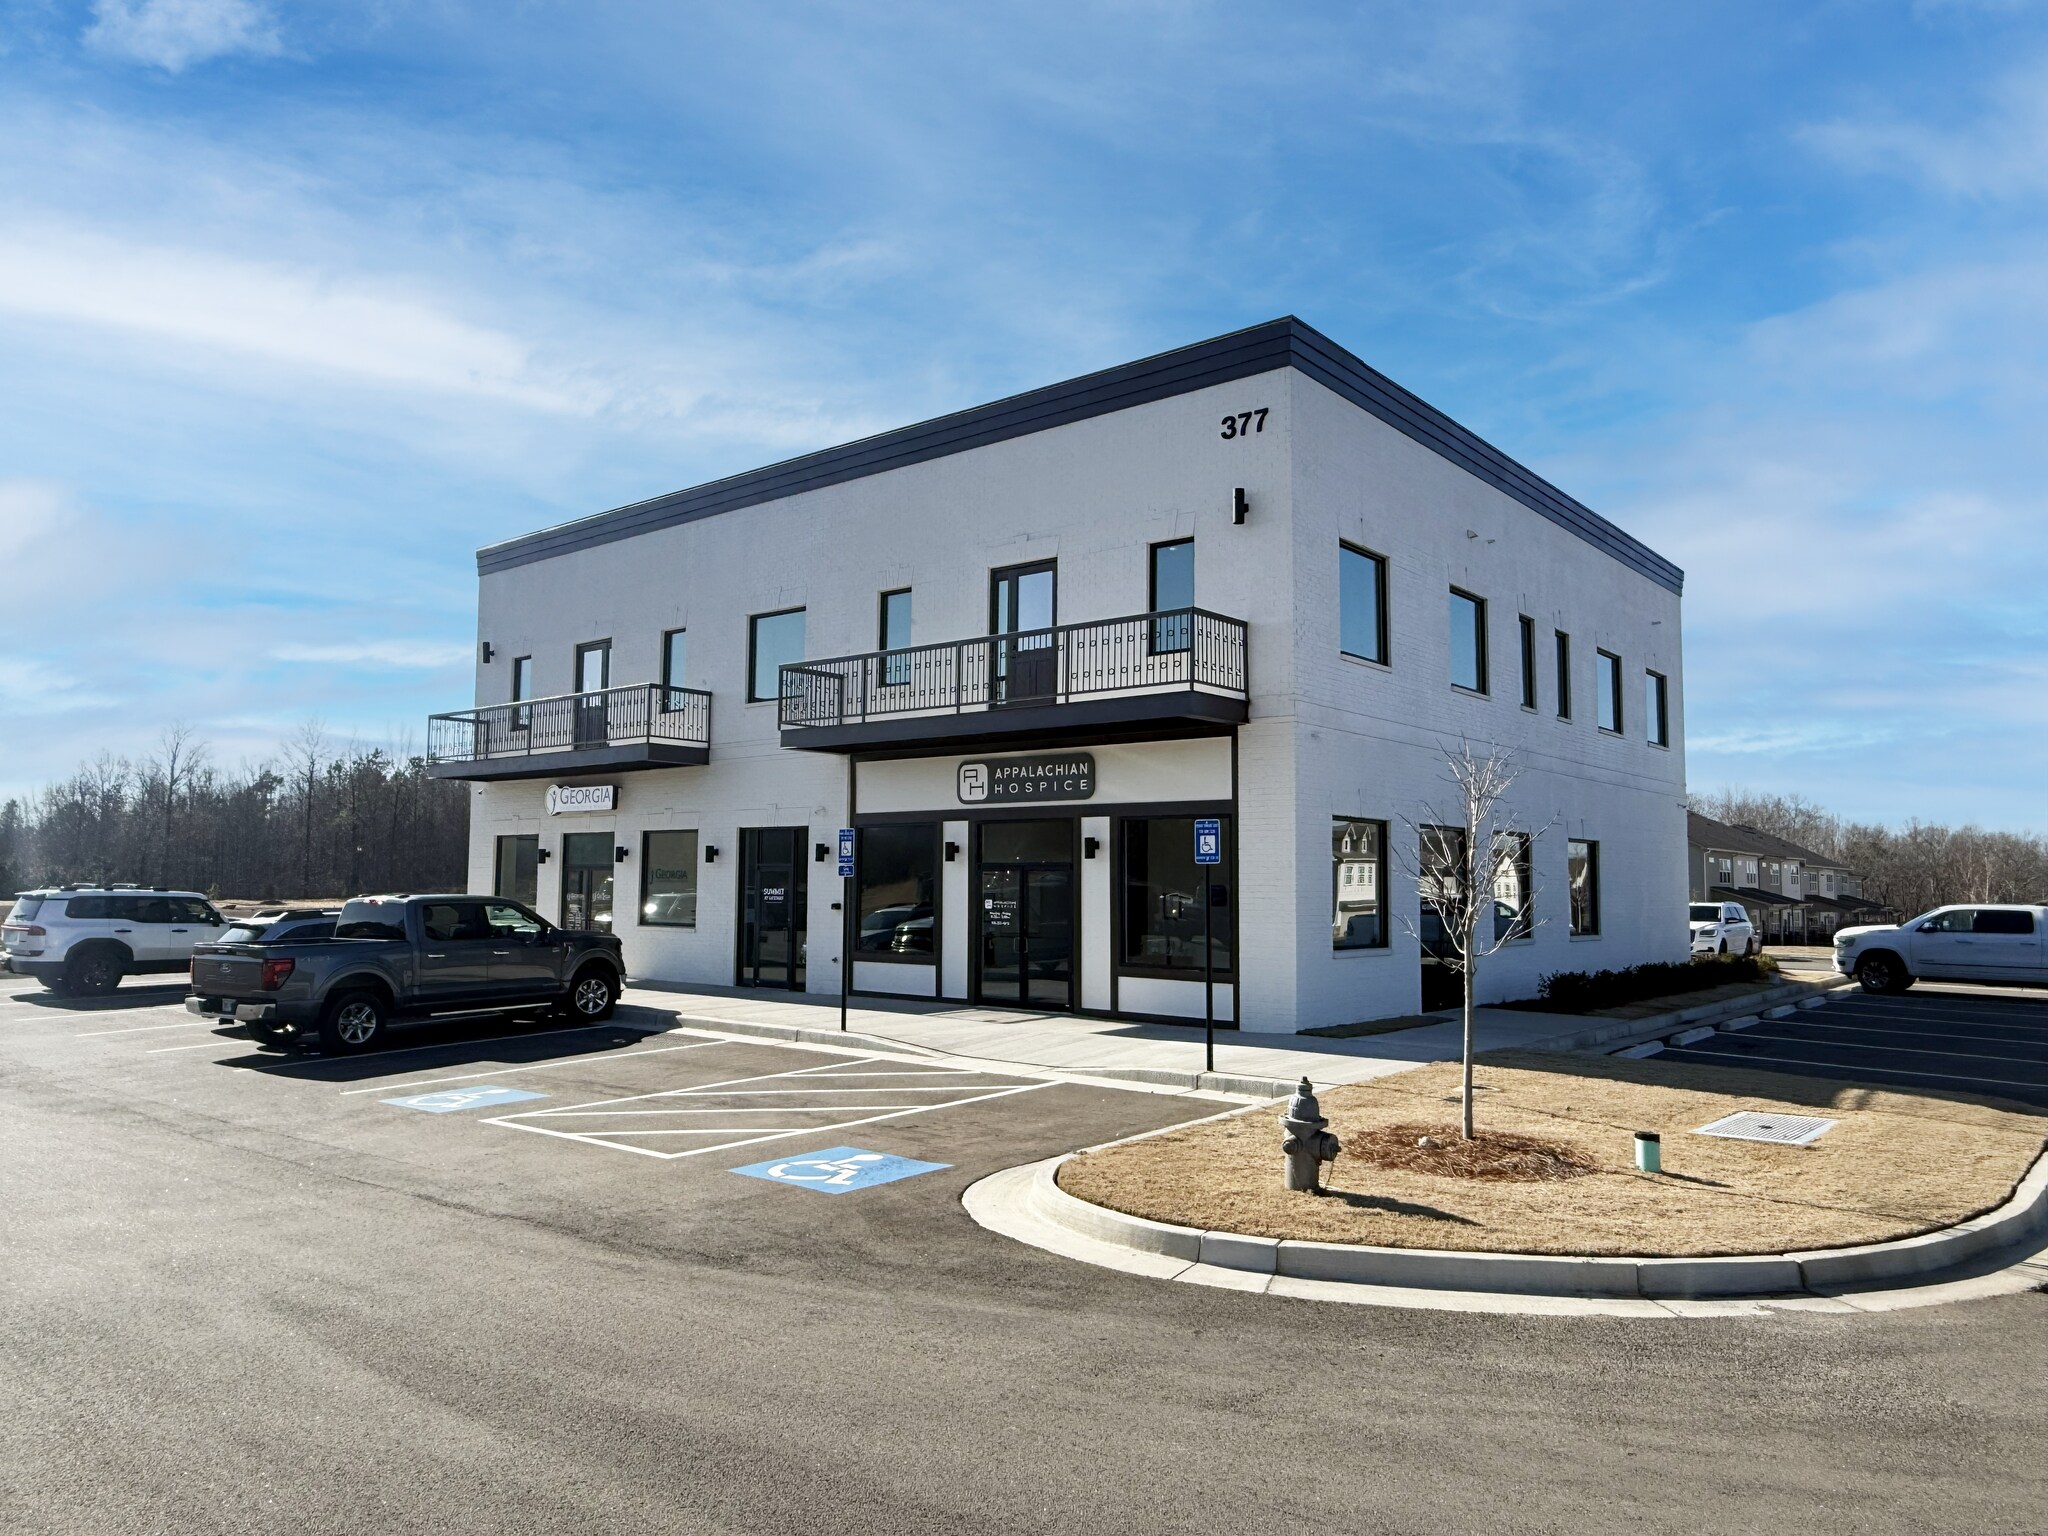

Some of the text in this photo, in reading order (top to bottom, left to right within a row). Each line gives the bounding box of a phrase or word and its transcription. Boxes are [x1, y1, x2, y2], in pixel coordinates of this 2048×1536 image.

[1221, 407, 1269, 440] 377
[994, 762, 1088, 779] APPALACHIAN
[994, 779, 1088, 794] HOSPICE
[560, 787, 611, 805] GEORGIA
